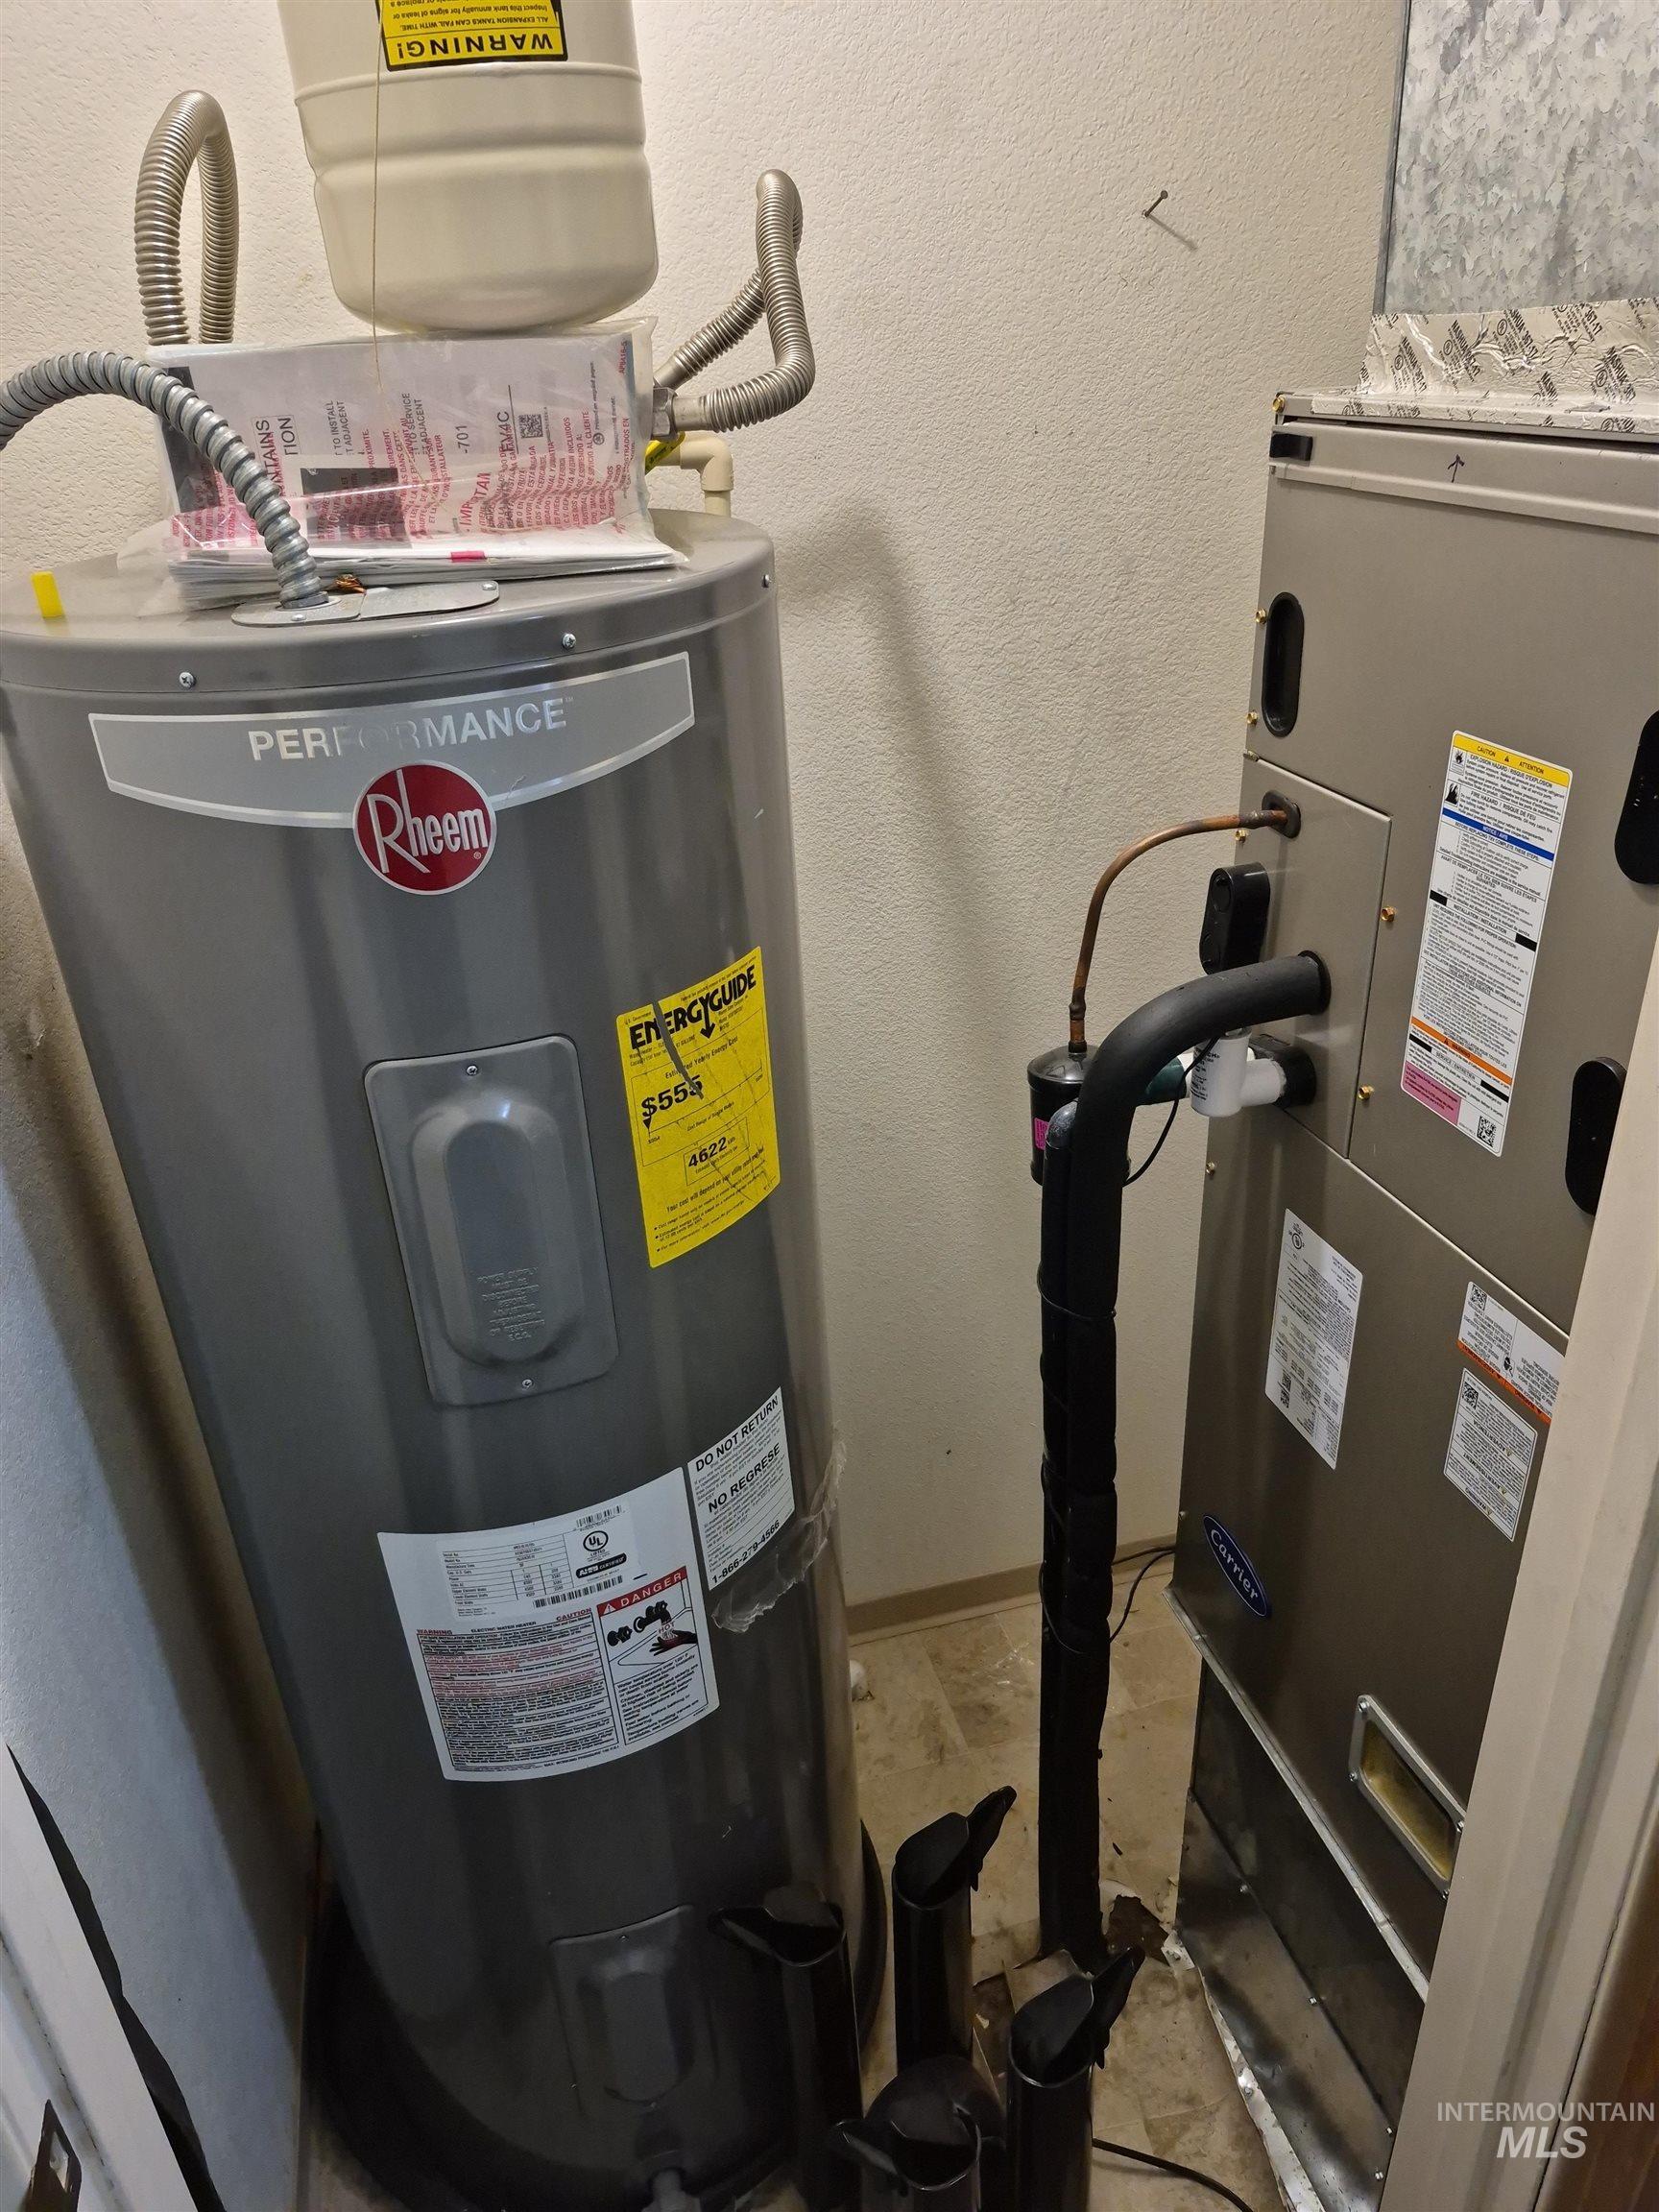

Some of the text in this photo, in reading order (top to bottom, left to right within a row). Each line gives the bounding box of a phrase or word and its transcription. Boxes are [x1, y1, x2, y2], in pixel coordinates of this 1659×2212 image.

[462, 5, 492, 13] annually
[397, 34, 552, 58] WARNING!
[1584, 308, 1603, 335] 367-17
[325, 399, 342, 447] TO INSTALL
[337, 399, 351, 445] ADJACENT
[401, 392, 414, 430] SERVICE
[414, 397, 429, 446] ADJACENT
[582, 411, 592, 438] CLIENTE
[455, 425, 470, 453] -701
[585, 439, 592, 448] AL
[247, 696, 568, 761] PERFORMANCE
[1477, 745, 1544, 774] CAUTION ATTENTION
[365, 768, 489, 875] Rheem
[629, 965, 757, 1050] ENERGYGUIDE
[687, 1137, 727, 1167] 4622
[696, 1396, 779, 1472] DO NOT RETURN
[709, 1493, 727, 1513] NO
[731, 1443, 781, 1494] REGRESE
[711, 1519, 780, 1584] 1-866-279-4566
[1212, 1529, 1258, 1599] Carrier
[620, 1572, 683, 1606] DANGER
[556, 1607, 592, 1622] CAUTION
